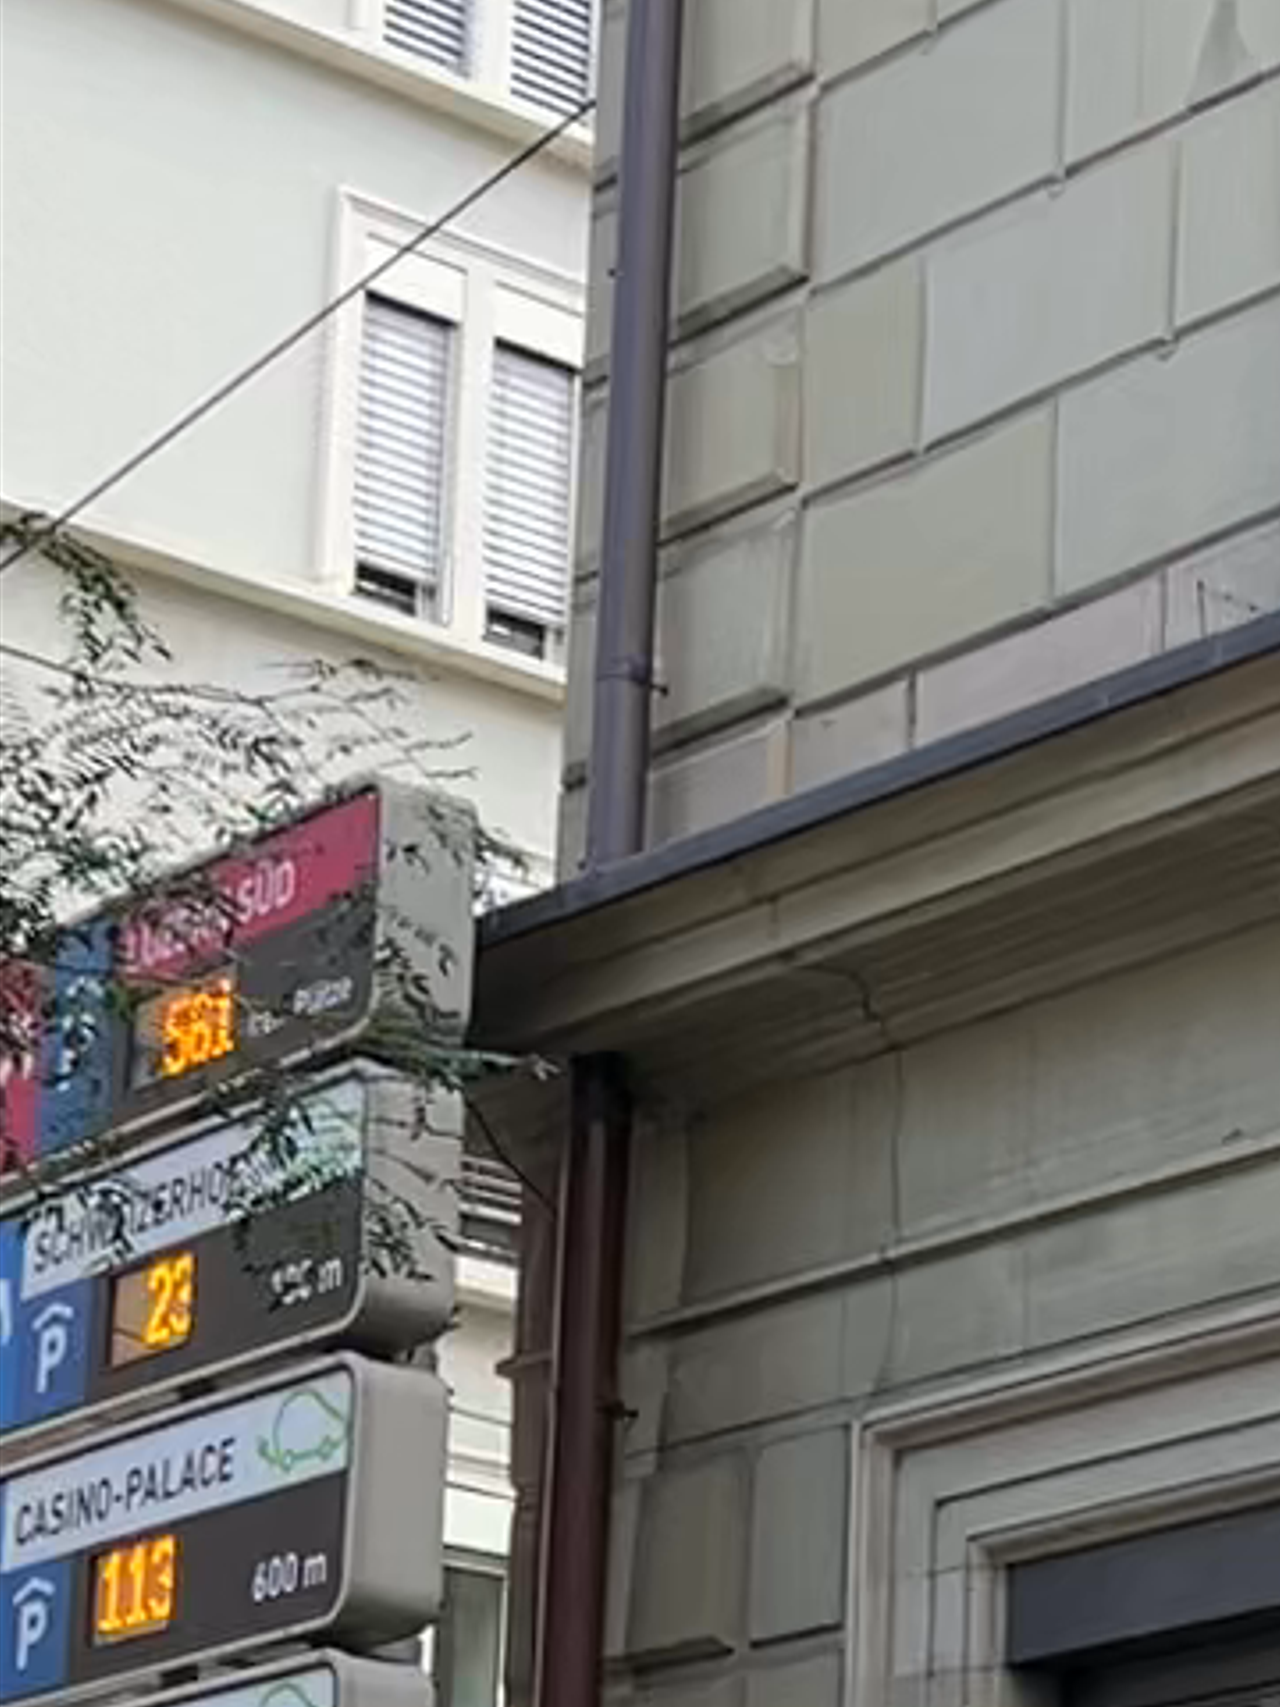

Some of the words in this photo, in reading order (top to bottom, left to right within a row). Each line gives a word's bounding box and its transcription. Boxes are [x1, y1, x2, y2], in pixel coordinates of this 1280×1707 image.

[236, 856, 296, 925] SÜD
[33, 1157, 243, 1273] SCHWIZERHO
[146, 1251, 194, 1344] 23
[15, 1437, 235, 1545] CASINO-PALACE
[99, 1534, 176, 1631] 113
[252, 1552, 298, 1602] 600
[303, 1554, 327, 1589] m
